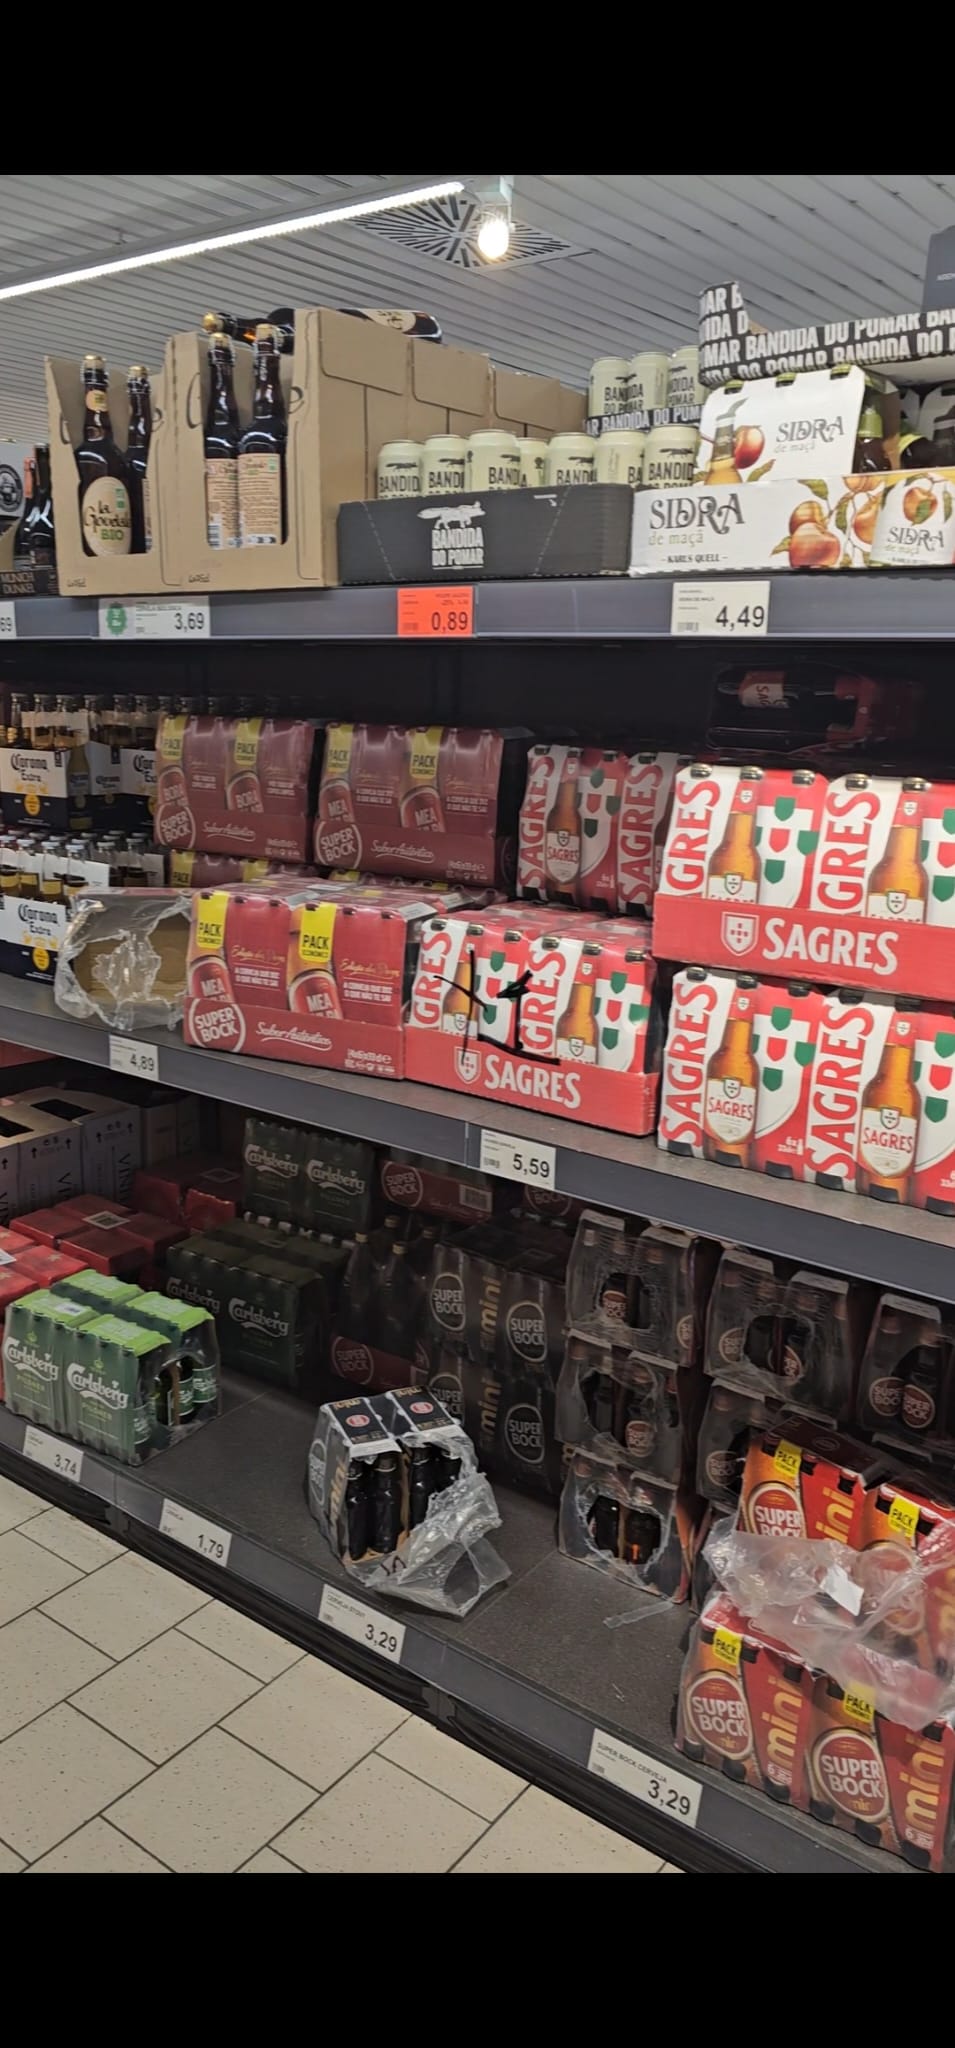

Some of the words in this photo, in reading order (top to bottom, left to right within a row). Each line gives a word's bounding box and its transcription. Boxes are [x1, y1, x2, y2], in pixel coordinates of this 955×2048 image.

[745, 326, 819, 361] BANDIDA
[602, 410, 650, 432] BANDIDA
[653, 408, 670, 425] DO
[775, 416, 845, 443] SIDRA
[649, 493, 745, 534] SIDRA
[101, 528, 125, 540] BIO
[432, 527, 485, 550] BANDIDA
[648, 532, 665, 546] de
[668, 530, 704, 548] maçã
[887, 526, 945, 552] SIDRA
[432, 550, 447, 567] DO
[448, 548, 485, 567] POMAR
[174, 612, 205, 633] 3,69
[431, 611, 469, 632] 0,89
[715, 605, 766, 633] 4,49
[11, 752, 49, 772] Corona
[413, 754, 436, 768] PACK
[21, 769, 43, 783] Extra
[160, 810, 190, 830] SUPER
[415, 808, 437, 826] MEA
[517, 756, 556, 890] SAGRES
[164, 823, 192, 843] BOCK
[320, 828, 353, 850] SUPER
[620, 764, 664, 906] SAGRES
[325, 842, 357, 862] BOCK
[18, 903, 61, 927] Corona
[30, 924, 52, 937] Extra
[199, 922, 222, 937] PACK
[302, 934, 330, 951] PACK
[762, 916, 899, 976] SAGRES
[201, 978, 226, 996] MEA
[306, 993, 334, 1013] MEA
[195, 1007, 236, 1030] SUPER
[201, 1021, 240, 1043] BOCK
[130, 1053, 155, 1072] 4,89
[660, 982, 719, 1148] SAGRES
[483, 1053, 582, 1110] SAGRES
[803, 1006, 875, 1182] SAGRES
[708, 1096, 754, 1121] SAGRES
[863, 1126, 914, 1154] SAGRES
[244, 1144, 299, 1178] Carlsberg
[512, 1153, 550, 1178] 5,59
[307, 1159, 366, 1195] Carlsberg
[385, 1172, 417, 1188] SUPER
[391, 1182, 418, 1196] BOCK
[228, 1297, 289, 1337] Carlsberg
[435, 1301, 465, 1315] BOCK
[510, 1317, 545, 1333] SUPER
[513, 1331, 545, 1346] BOCK
[4, 1336, 60, 1381] Carlsberg
[66, 1362, 129, 1410] Carlsberg
[509, 1419, 543, 1435] SUPER
[512, 1433, 544, 1448] BOCK
[54, 1453, 78, 1476] 3,74
[776, 1450, 797, 1467] PACK
[755, 1505, 802, 1528] SUPER
[892, 1509, 915, 1527] PACK
[197, 1533, 225, 1559] 1,79
[364, 1623, 398, 1653] 3,29
[715, 1638, 738, 1656] PACK
[692, 1696, 747, 1720] SUPER
[846, 1693, 872, 1713] PACK
[699, 1715, 748, 1737] BOCK
[762, 1675, 803, 1768] mini
[597, 1741, 618, 1758] SUPER
[618, 1753, 637, 1768] BOCK
[637, 1762, 668, 1784] CERVEJA
[821, 1755, 882, 1780] SUPER
[829, 1774, 885, 1800] BOCK
[899, 1734, 946, 1833] mini
[647, 1779, 691, 1815] 3,29
